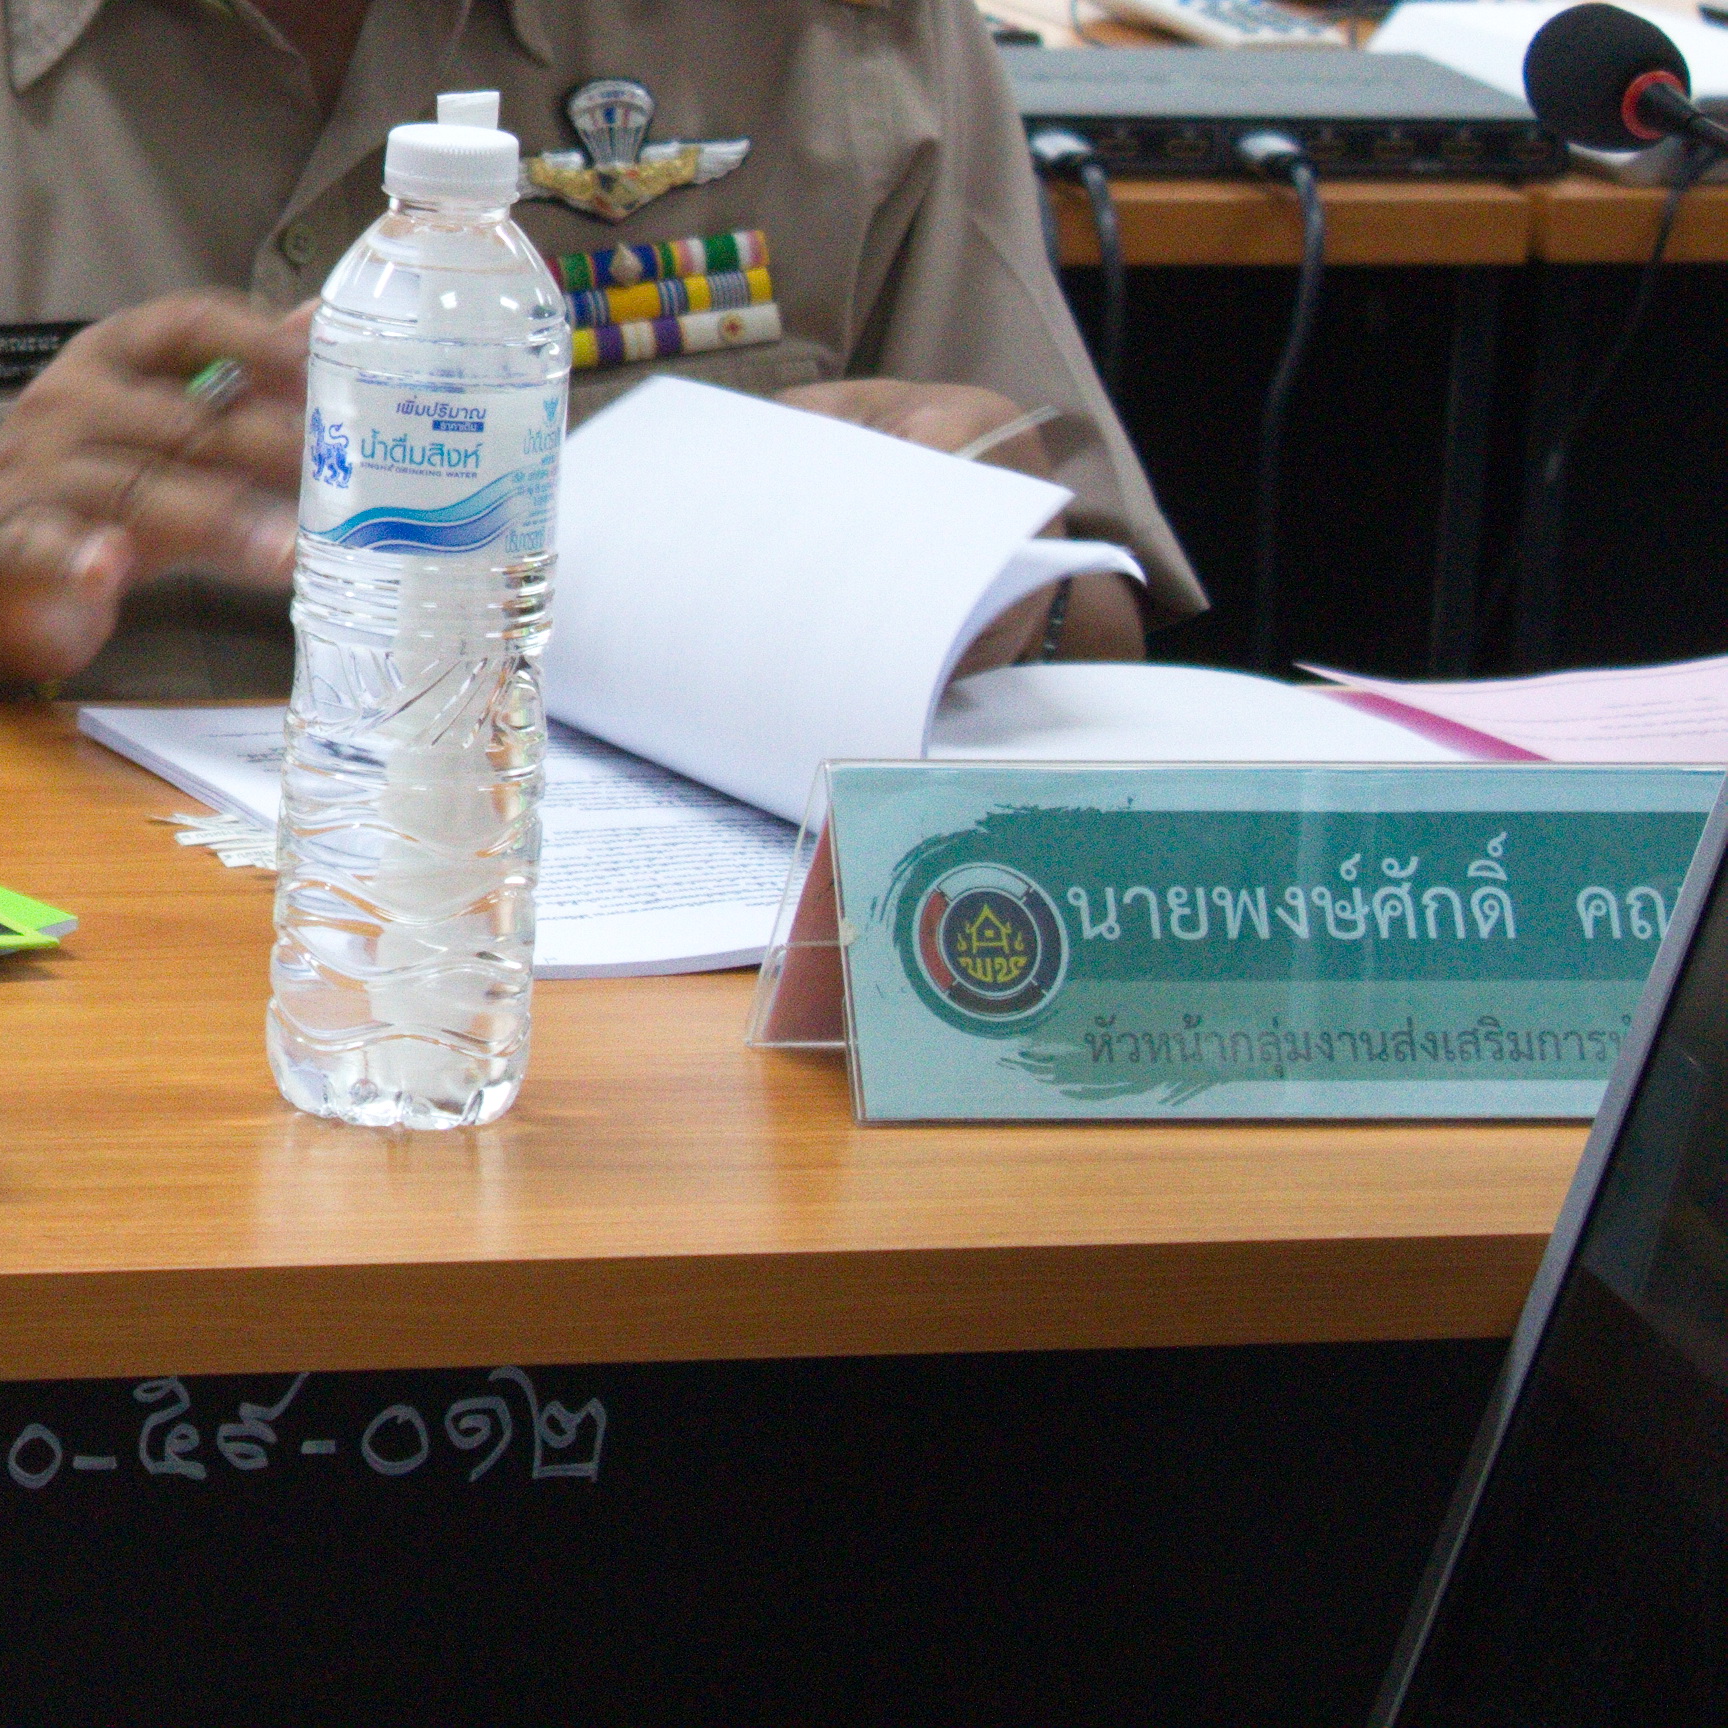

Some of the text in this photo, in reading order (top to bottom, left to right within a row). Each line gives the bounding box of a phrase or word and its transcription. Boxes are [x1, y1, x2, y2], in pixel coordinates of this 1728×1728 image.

[396, 394, 486, 420] เพิ่มปริมาณ
[361, 428, 483, 468] น้ำดื่มสิงห์
[395, 467, 442, 478] DRINKING
[1067, 831, 1517, 942] นายพงษ์ศักดิ์
